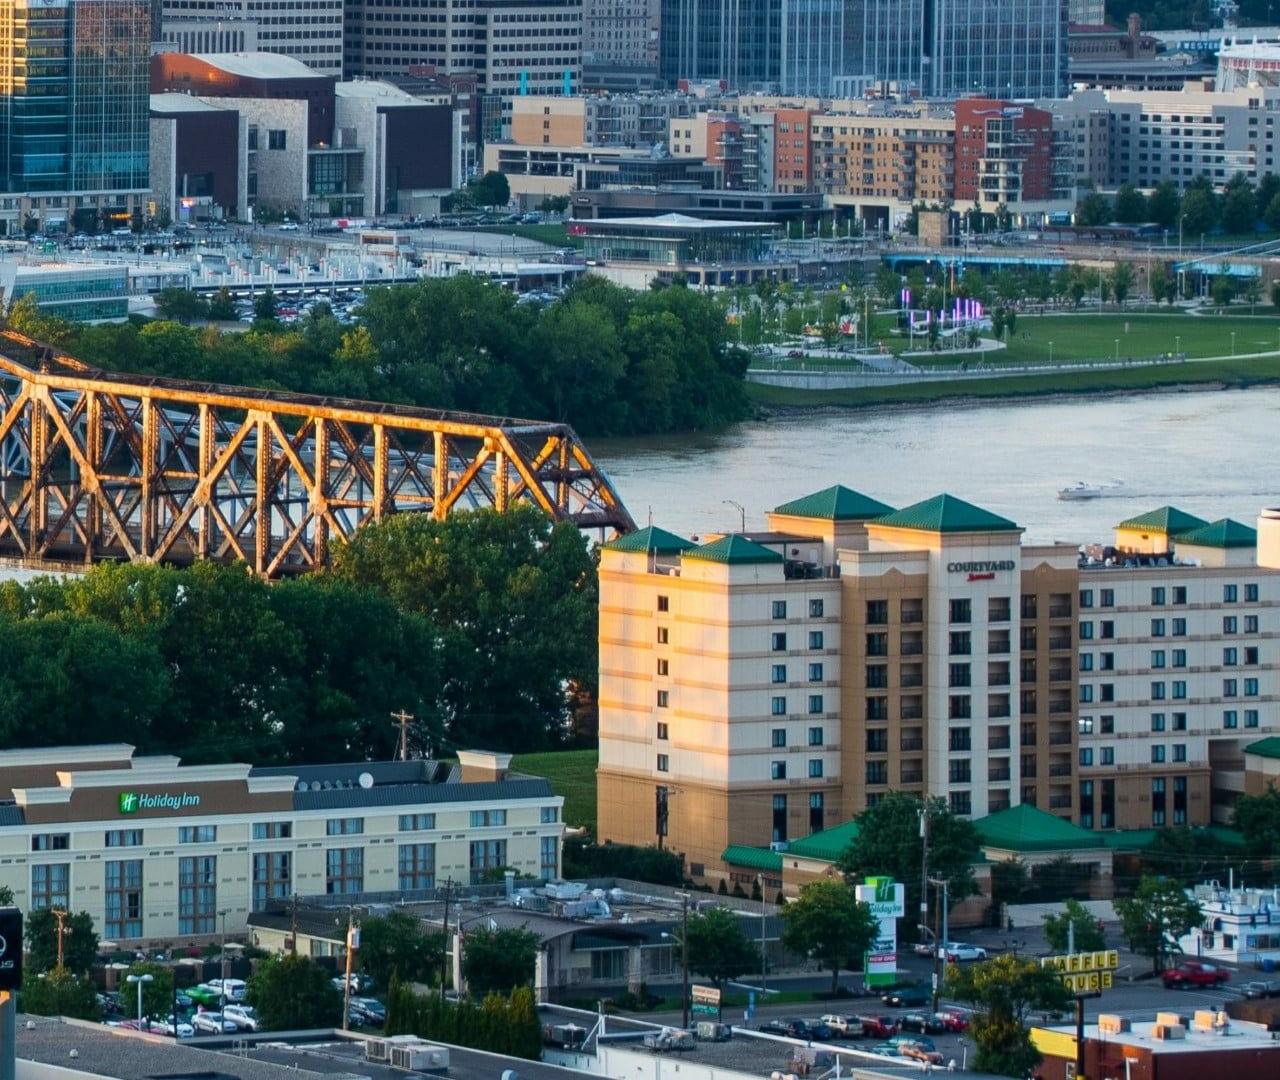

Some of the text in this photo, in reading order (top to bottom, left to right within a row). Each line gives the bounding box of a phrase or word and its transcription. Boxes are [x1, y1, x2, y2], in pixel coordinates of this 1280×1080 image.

[947, 560, 1015, 572] COURTYARD
[139, 792, 200, 809] Holiday Inn
[871, 904, 891, 914] oliday
[1045, 954, 1117, 971] AFFLE
[1065, 973, 1111, 990] OUSE
